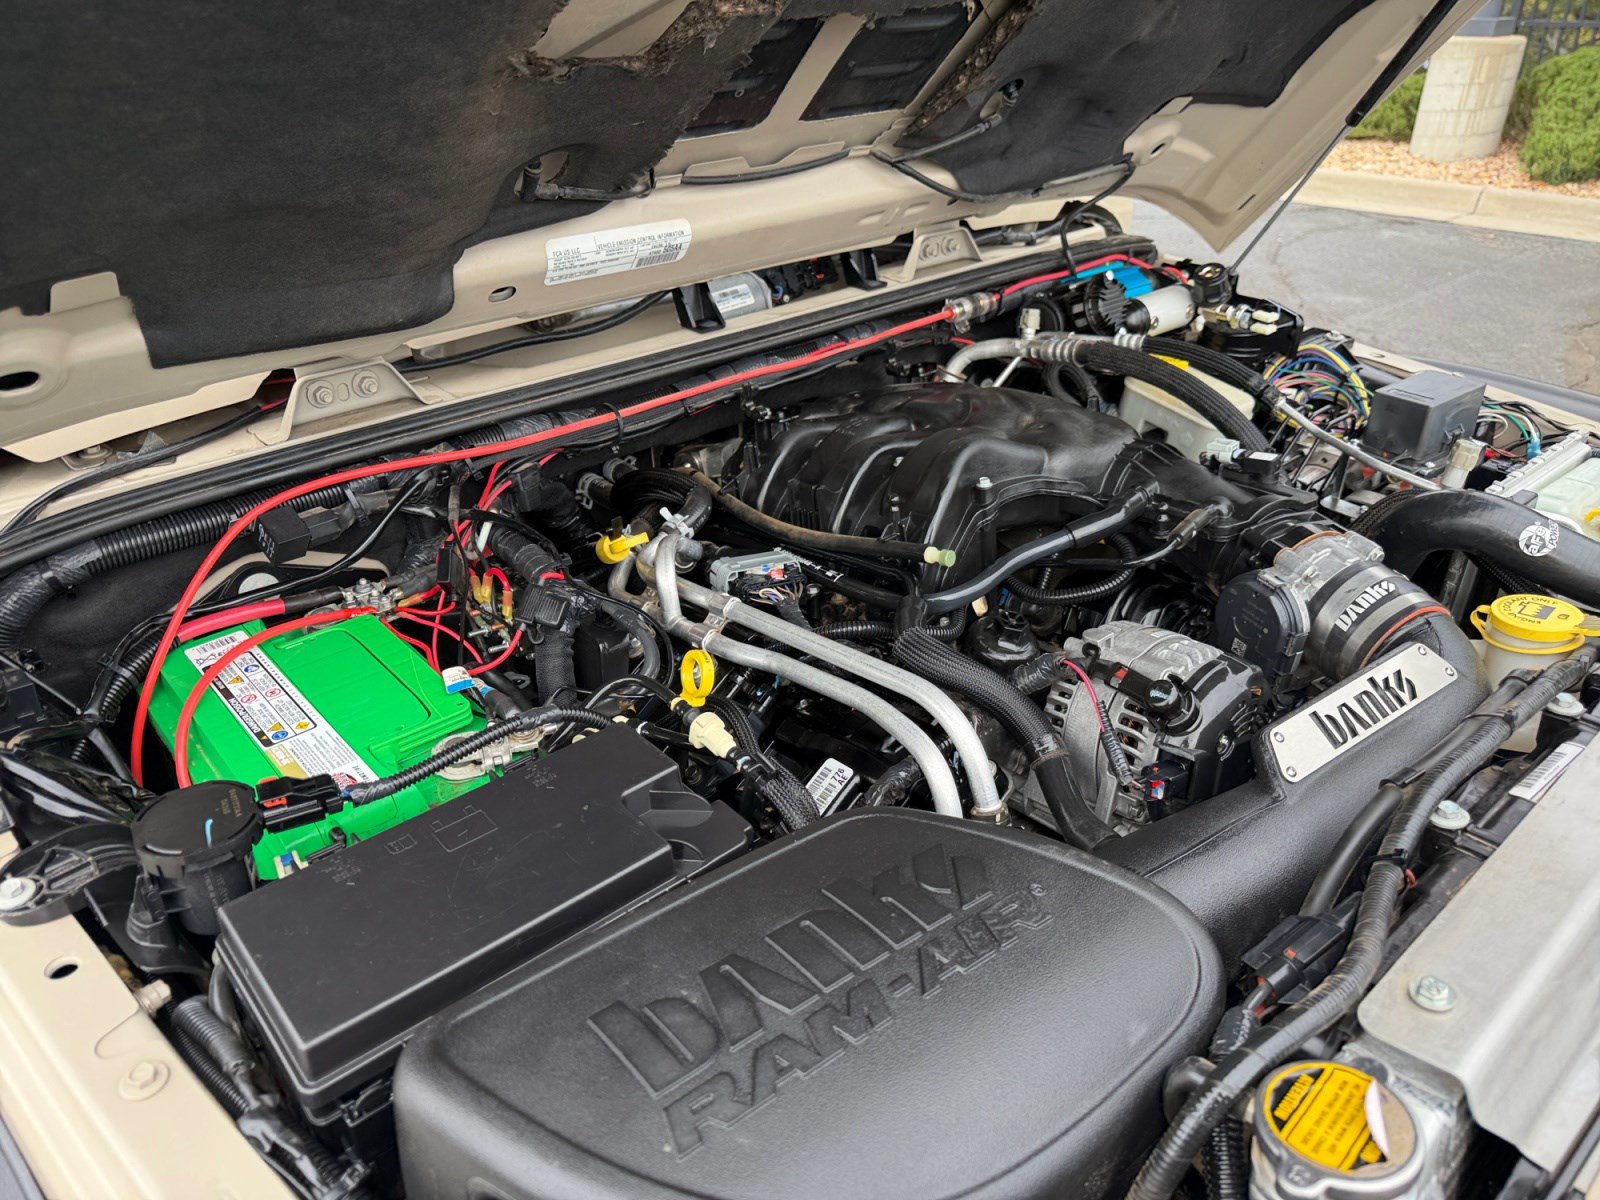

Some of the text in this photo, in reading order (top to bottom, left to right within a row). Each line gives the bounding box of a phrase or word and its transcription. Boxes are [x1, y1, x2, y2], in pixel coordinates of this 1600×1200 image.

[598, 242, 616, 250] VEHICLE
[637, 236, 656, 244] CONTROL
[657, 230, 685, 241] INFORMATION
[552, 249, 563, 257] FCA
[831, 768, 845, 781] 776
[838, 775, 848, 786] AE
